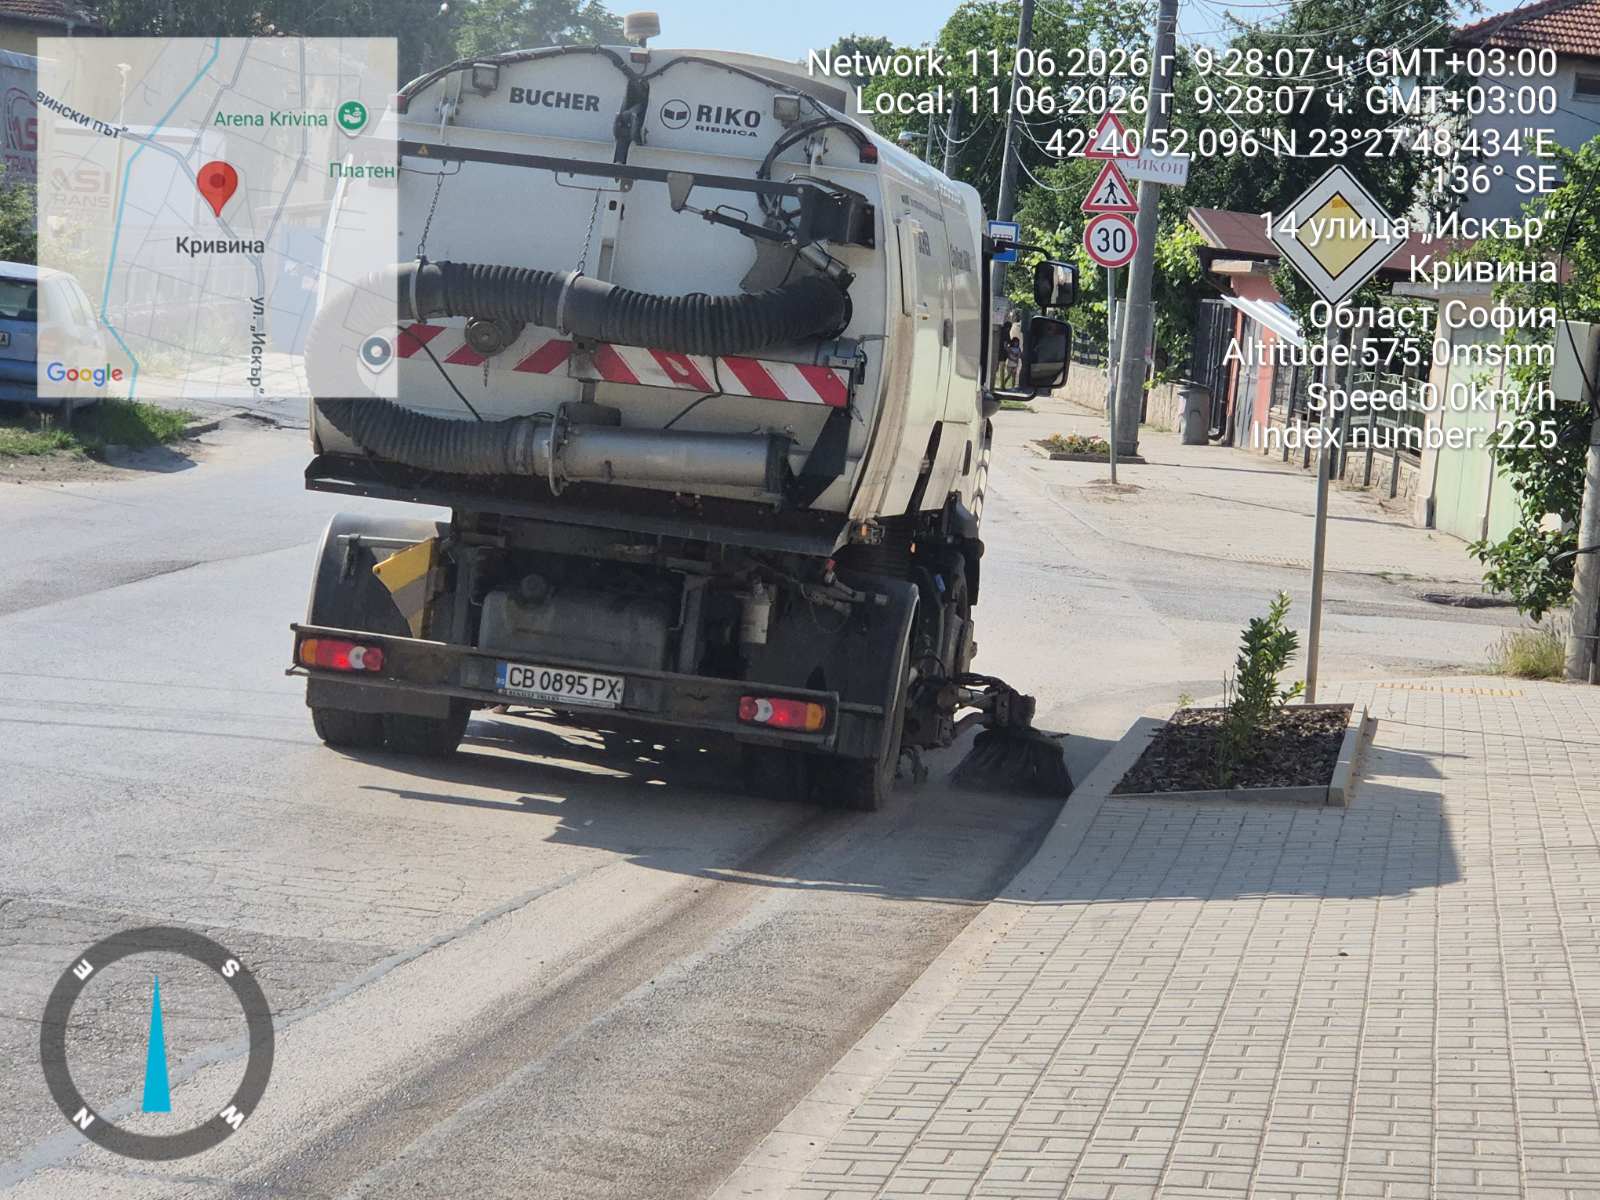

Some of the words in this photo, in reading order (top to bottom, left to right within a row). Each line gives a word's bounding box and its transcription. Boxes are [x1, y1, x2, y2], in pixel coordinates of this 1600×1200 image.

[509, 86, 600, 112] BUCHER
[695, 104, 762, 129] RIKO
[695, 125, 758, 137] RIBNICA
[1096, 227, 1126, 253] 30
[509, 667, 535, 688] CB
[540, 671, 588, 695] 0895
[592, 678, 620, 700] PX
